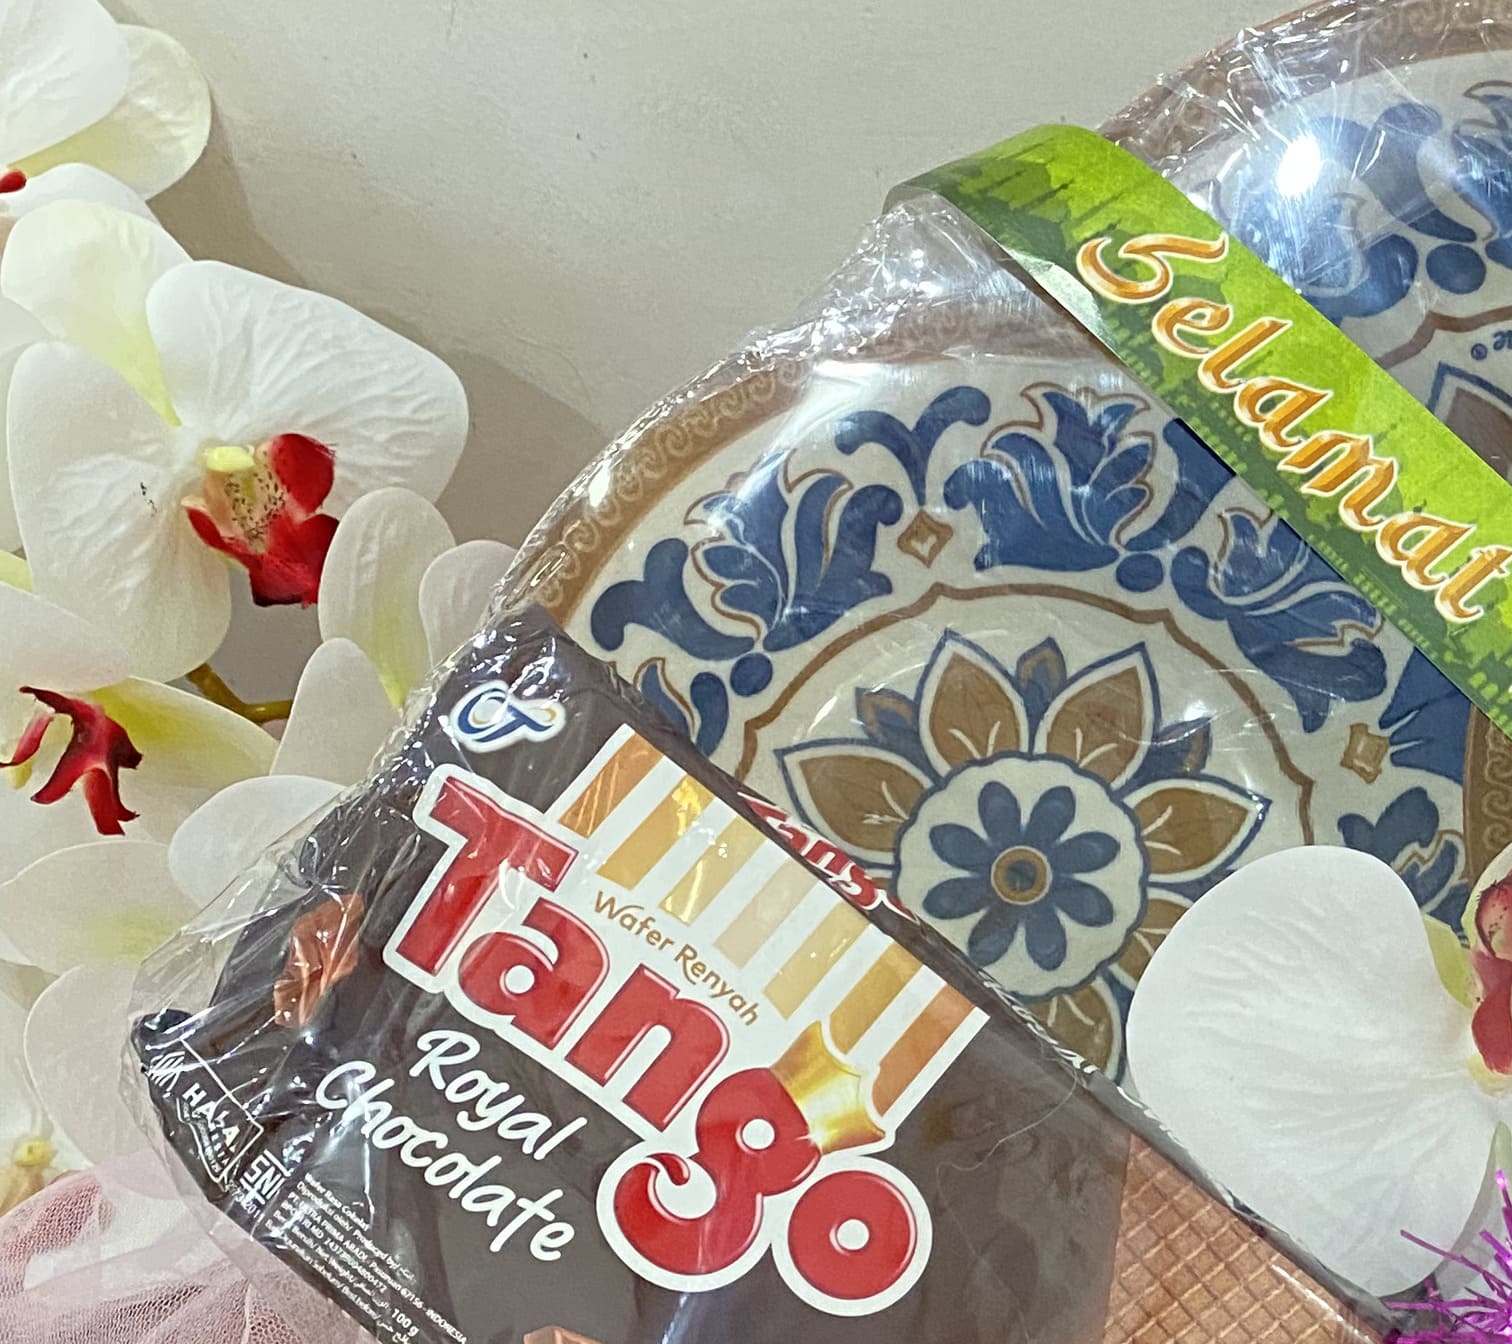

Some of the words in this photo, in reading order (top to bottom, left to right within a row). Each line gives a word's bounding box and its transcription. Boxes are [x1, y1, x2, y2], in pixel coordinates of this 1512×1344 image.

[594, 892, 673, 952] Wafer
[675, 945, 759, 1027] Renyah
[390, 770, 924, 1308] Tango
[409, 1030, 587, 1160] Royal
[241, 1153, 287, 1200] SNI
[313, 1059, 576, 1261] Chocolate
[309, 1224, 325, 1239] MD
[351, 1228, 387, 1261] Produced
[390, 1308, 412, 1329] 100
[399, 1286, 424, 1309] 67156
[424, 1307, 468, 1344] INDONESIA
